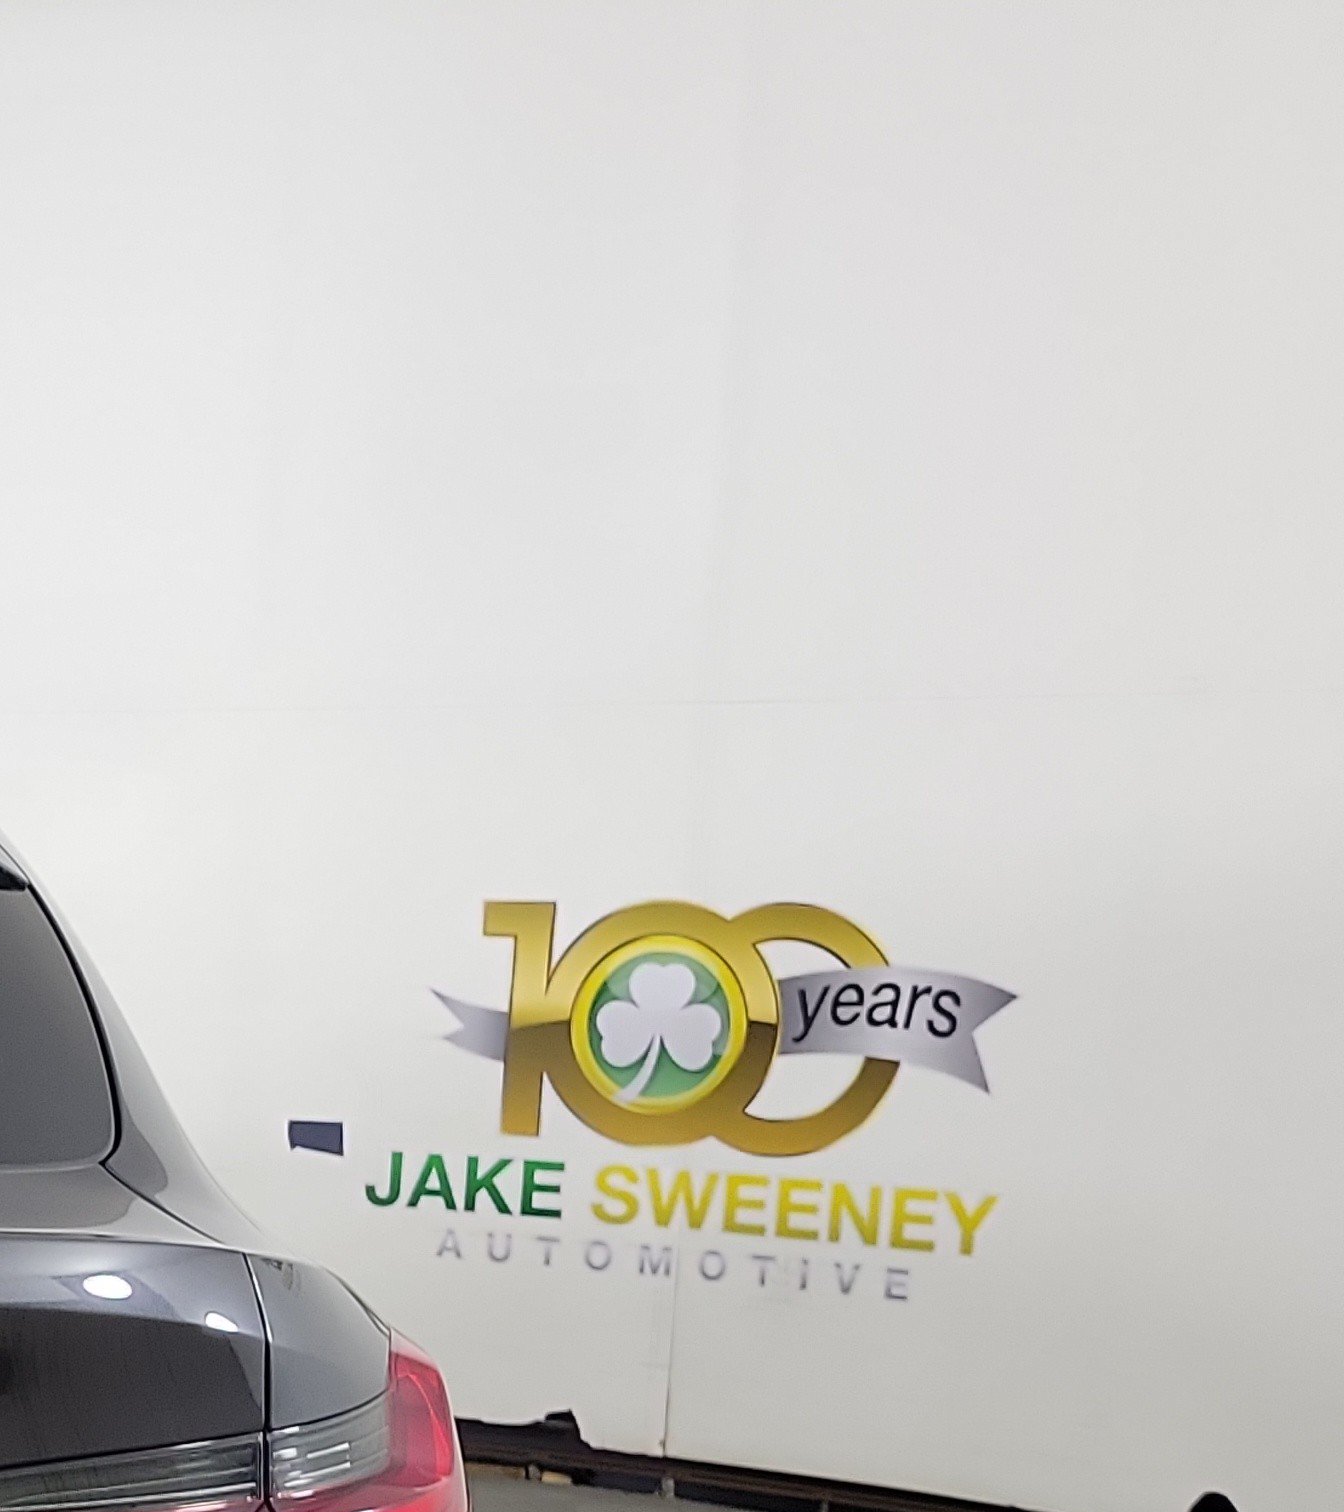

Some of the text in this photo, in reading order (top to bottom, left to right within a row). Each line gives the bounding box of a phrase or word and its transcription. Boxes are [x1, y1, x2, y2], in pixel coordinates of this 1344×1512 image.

[791, 980, 962, 1041] years
[365, 1151, 998, 1256] JAKE SWEENEY
[436, 1228, 911, 1302] AUTOMOTIVE
